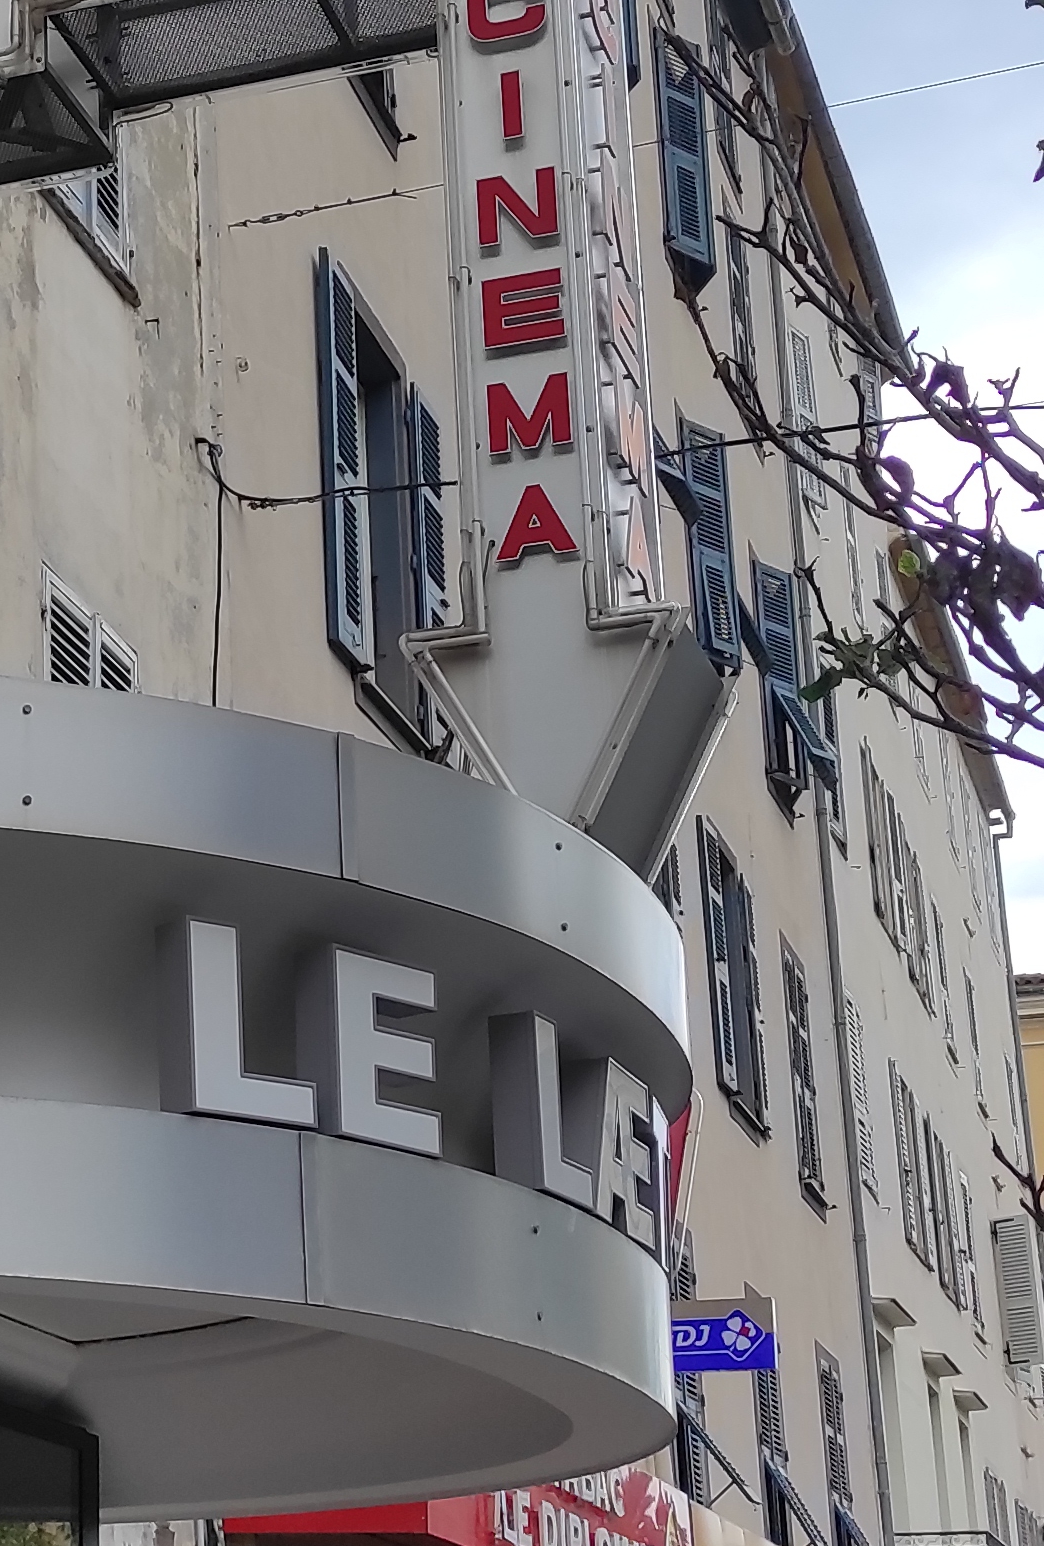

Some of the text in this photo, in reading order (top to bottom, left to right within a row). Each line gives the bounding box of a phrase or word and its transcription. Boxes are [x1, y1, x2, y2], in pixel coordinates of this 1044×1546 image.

[164, 915, 443, 1159] LE
[670, 1324, 711, 1348] DJ
[554, 1469, 626, 1518] ABAC
